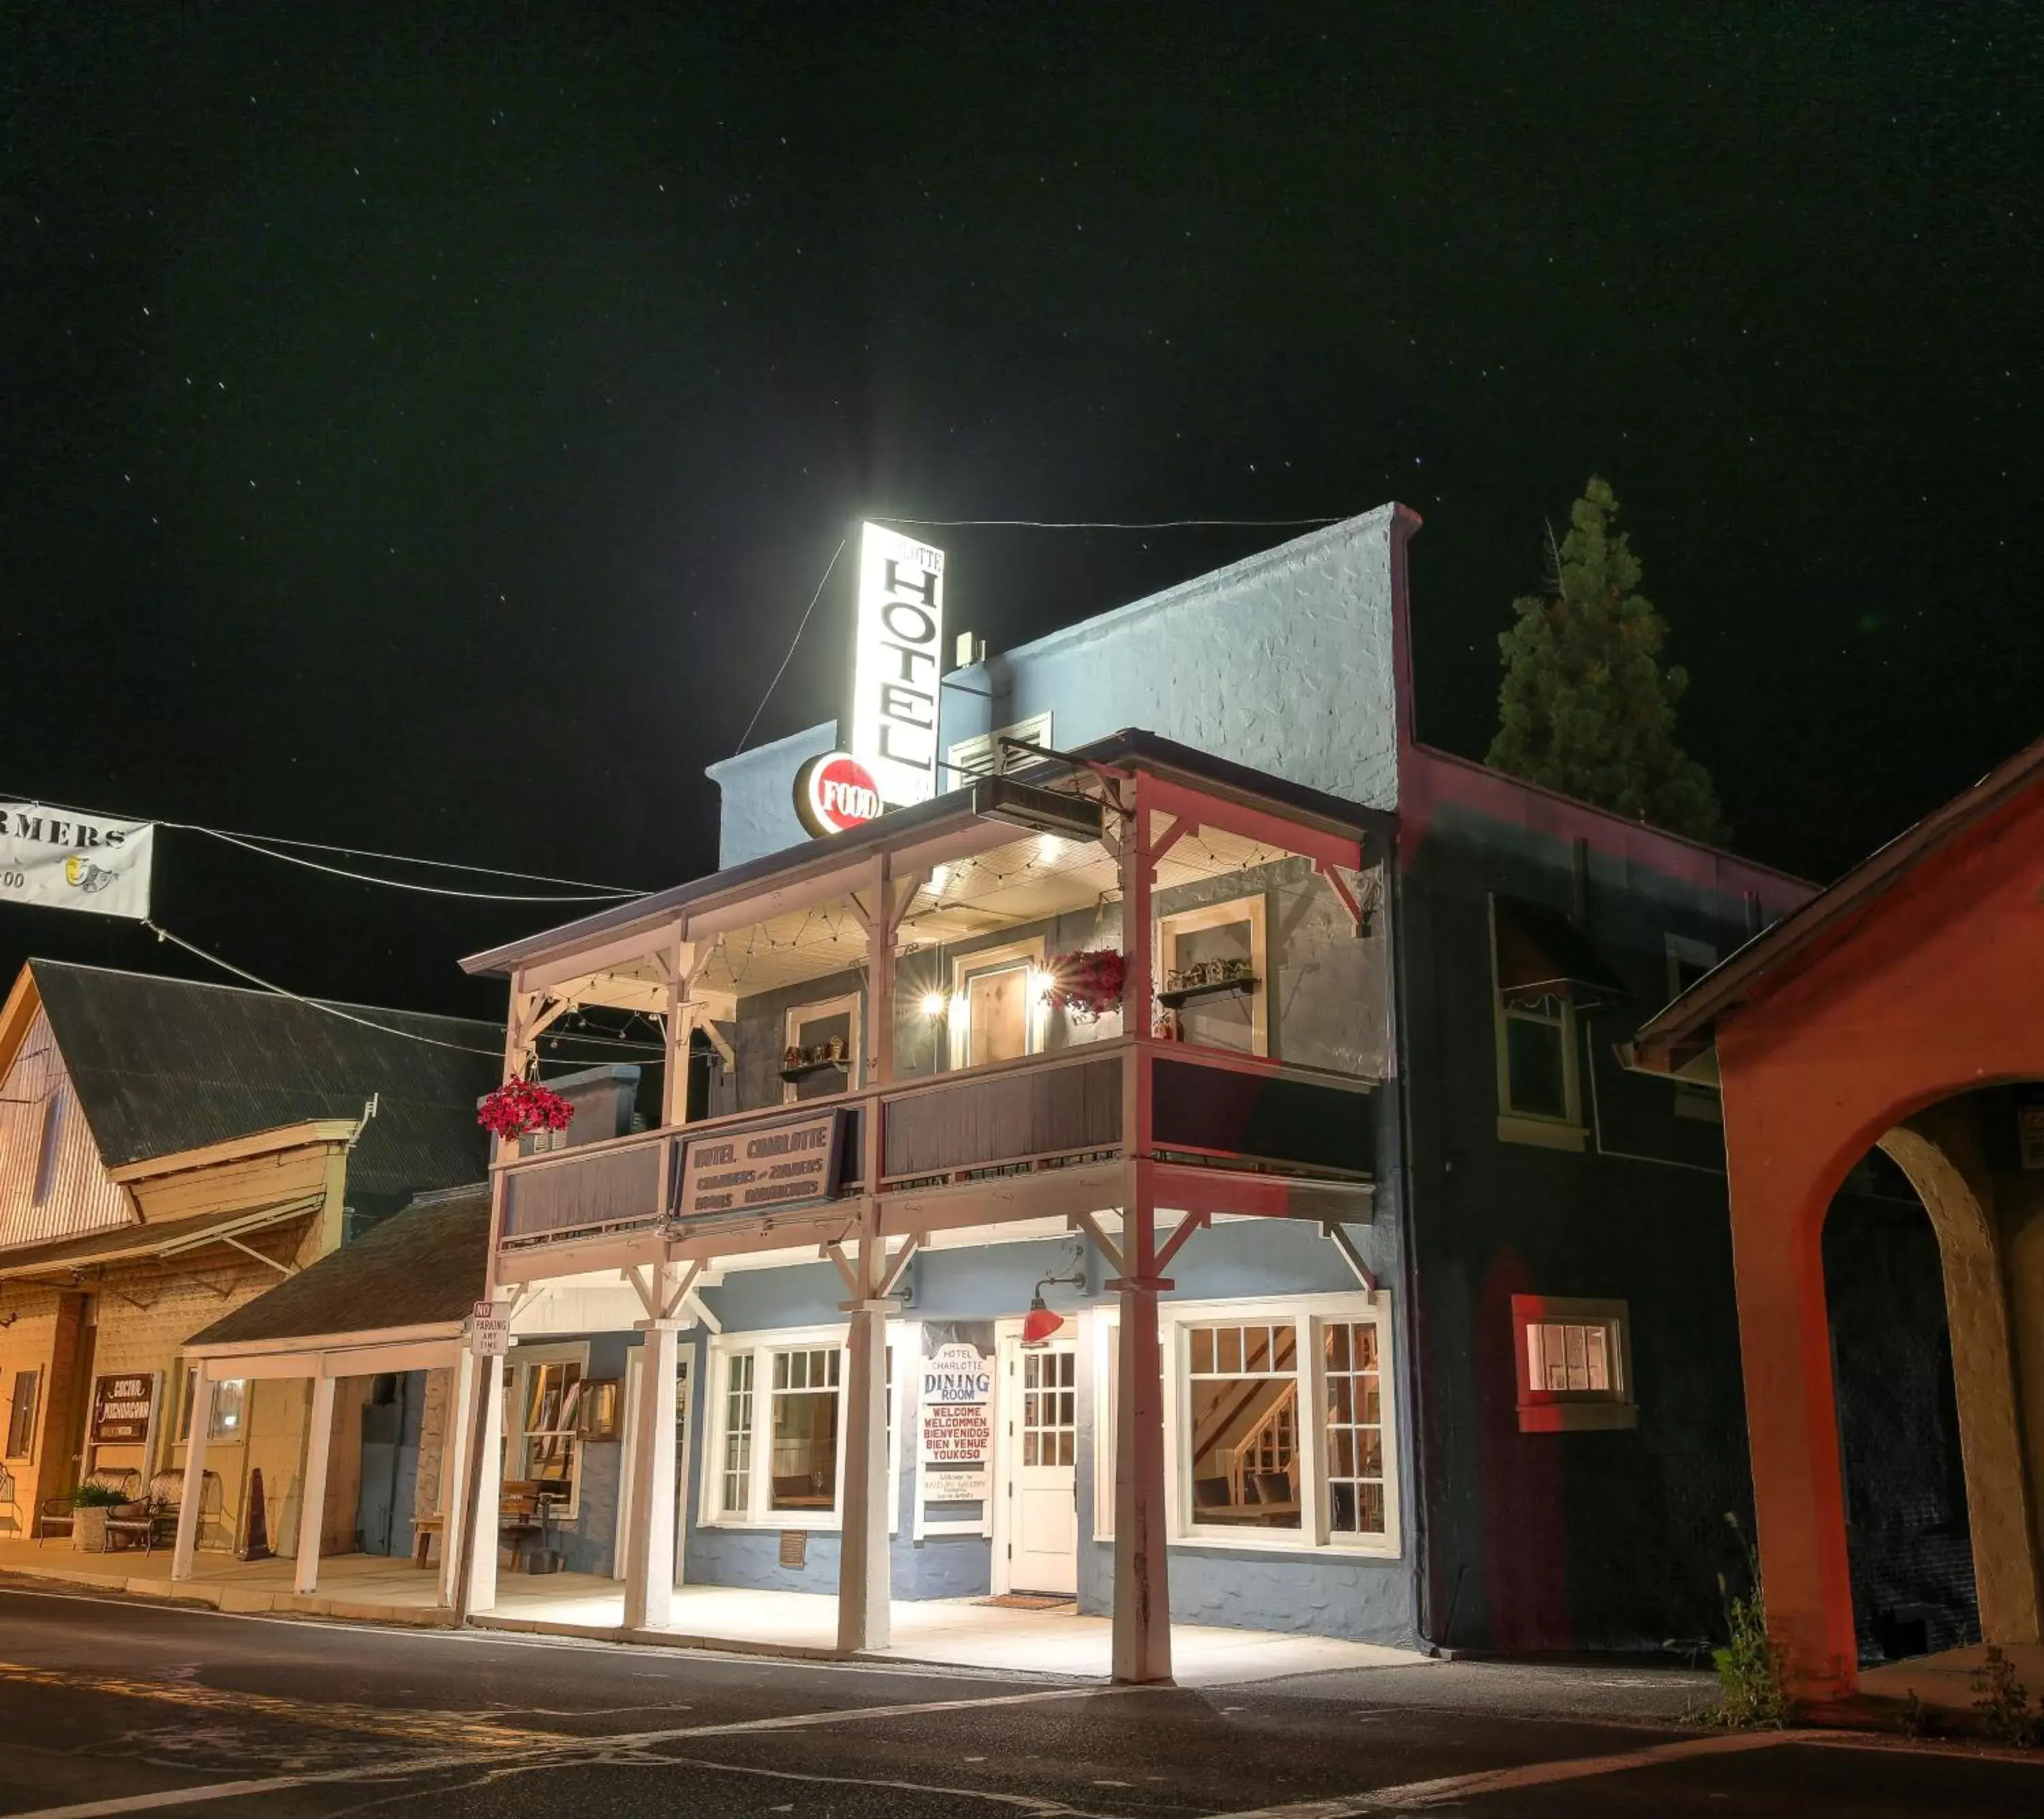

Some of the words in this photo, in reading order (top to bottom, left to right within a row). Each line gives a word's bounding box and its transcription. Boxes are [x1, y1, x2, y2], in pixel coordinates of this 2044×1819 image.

[878, 559, 938, 771] HOTEL
[823, 780, 879, 819] FOOD
[694, 1144, 737, 1169] HOTEL
[746, 1126, 828, 1159] CHARLOTTE
[477, 1303, 490, 1316] NO
[476, 1320, 506, 1331] PARKING
[482, 1331, 497, 1339] ANY
[480, 1340, 497, 1349] TIME
[944, 1350, 972, 1358] HOTEL
[933, 1361, 982, 1371] CHARLOTTE
[925, 1373, 990, 1394] DINING
[942, 1389, 975, 1401] ROOM
[933, 1407, 981, 1417] WELCOME
[925, 1418, 987, 1427] WELCOMMEN
[923, 1428, 990, 1439] BIENVENIDOS
[926, 1440, 949, 1449] BIEN
[954, 1439, 987, 1448] VENUE
[933, 1450, 980, 1459] YOUKOSO
